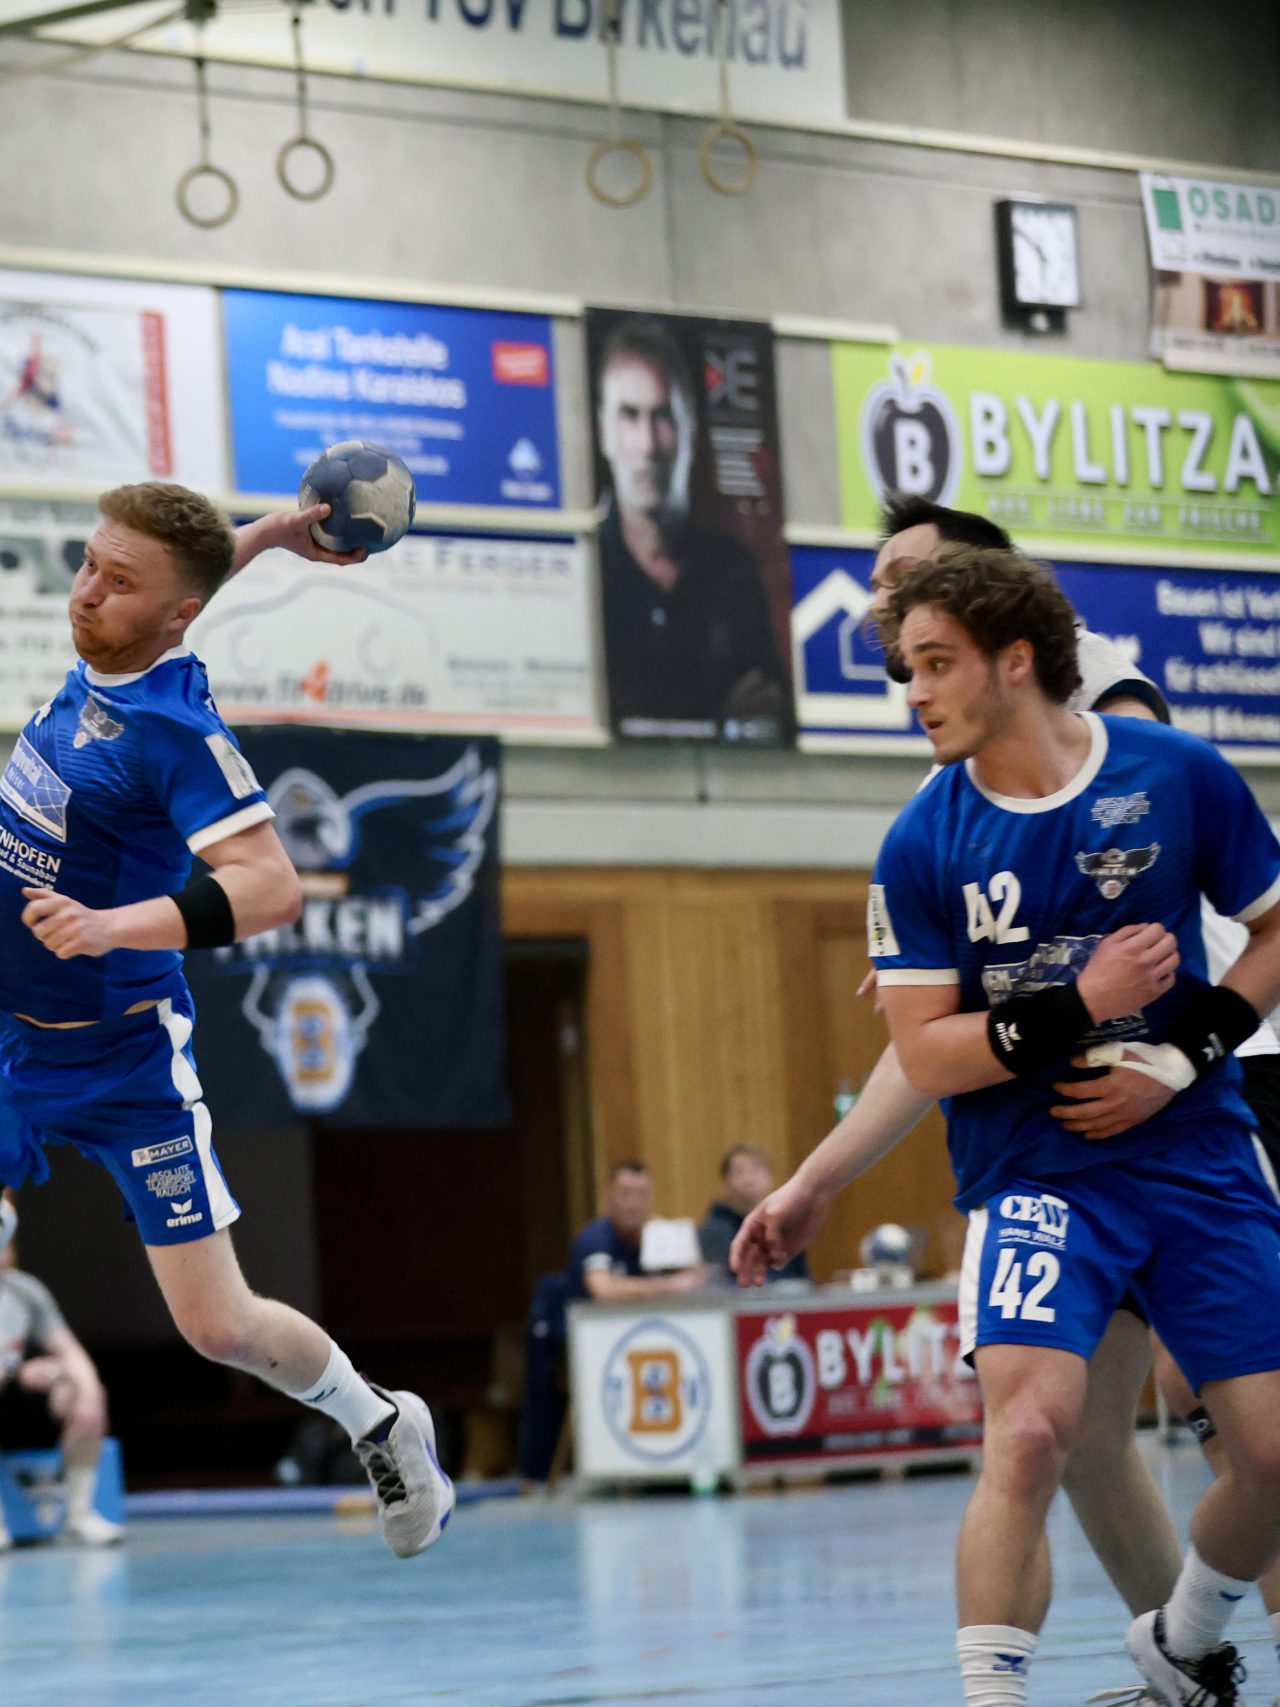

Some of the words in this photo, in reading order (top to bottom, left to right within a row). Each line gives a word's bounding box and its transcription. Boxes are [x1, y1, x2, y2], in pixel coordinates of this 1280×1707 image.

[969, 391, 1272, 496] BYLITZA
[962, 871, 1030, 945] 42
[150, 1139, 190, 1158] MAYER
[166, 1211, 203, 1227] erima
[988, 1248, 1060, 1323] 42
[816, 1322, 976, 1390] BYLITZ
